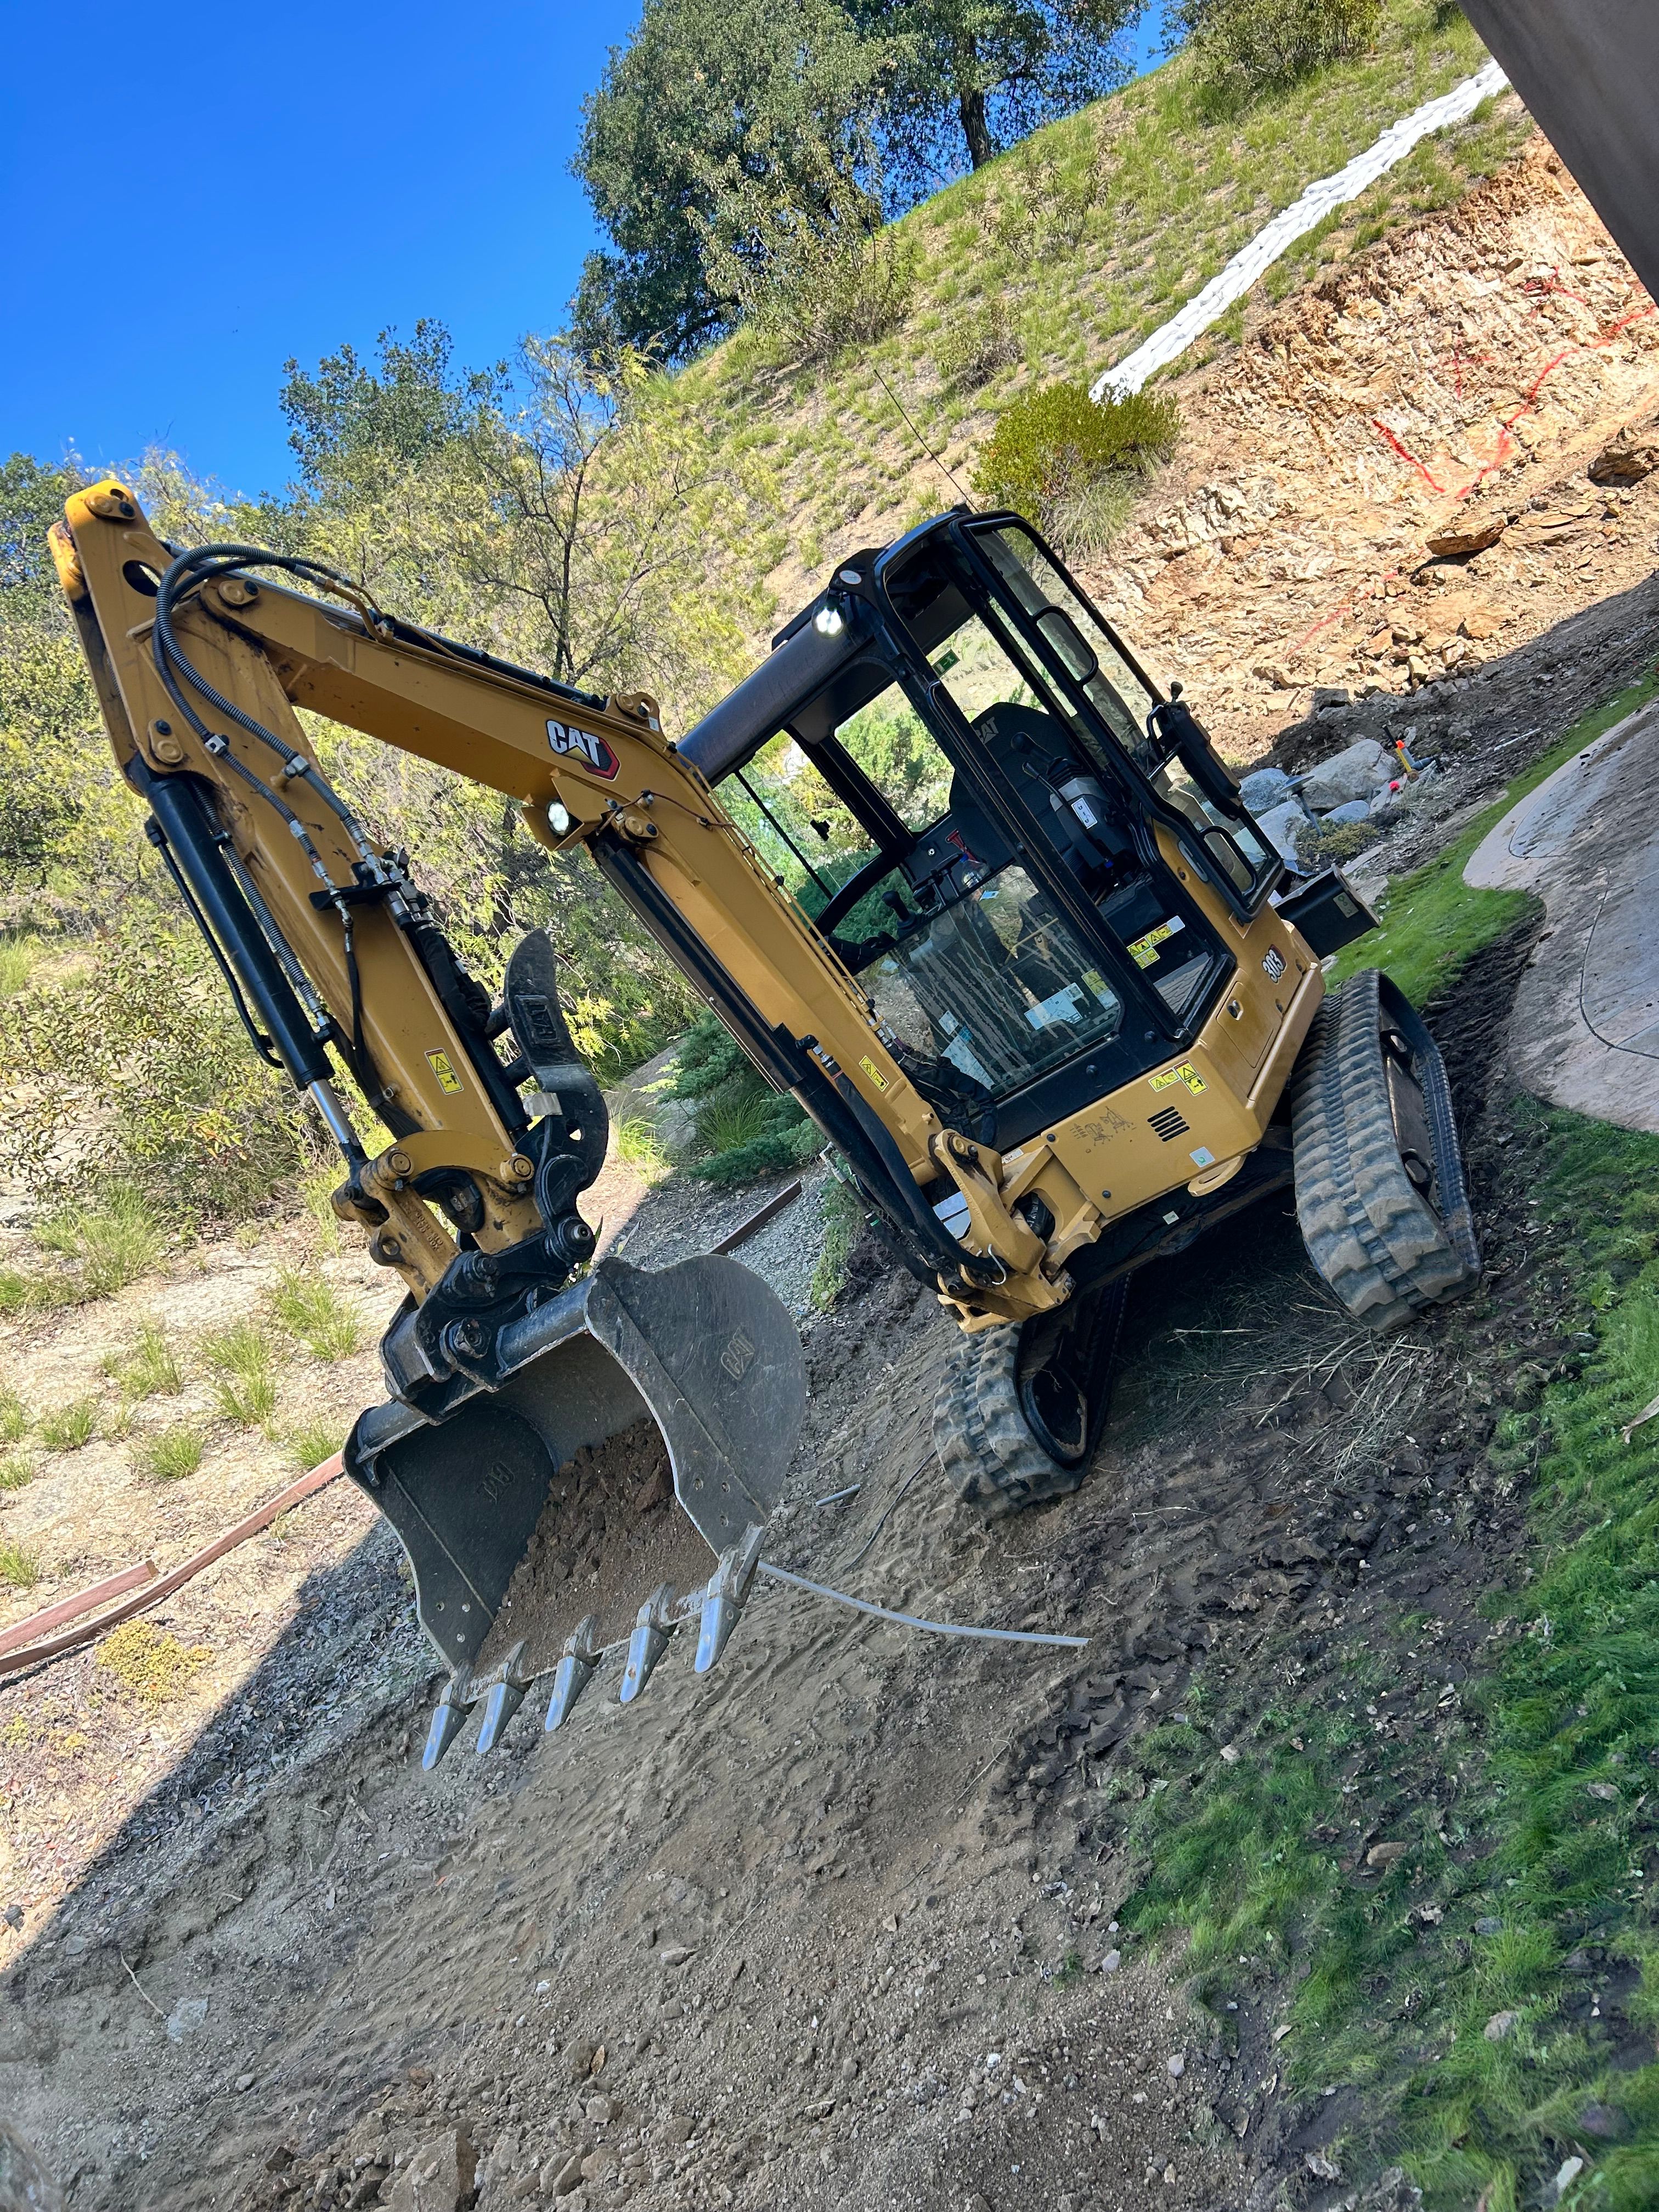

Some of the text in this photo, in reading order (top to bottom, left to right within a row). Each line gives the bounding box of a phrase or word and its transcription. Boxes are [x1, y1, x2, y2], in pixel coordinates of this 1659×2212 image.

[546, 720, 600, 768] CAT
[1262, 949, 1284, 983] 303
[529, 1005, 557, 1041] CAT
[721, 1328, 755, 1381] CAT
